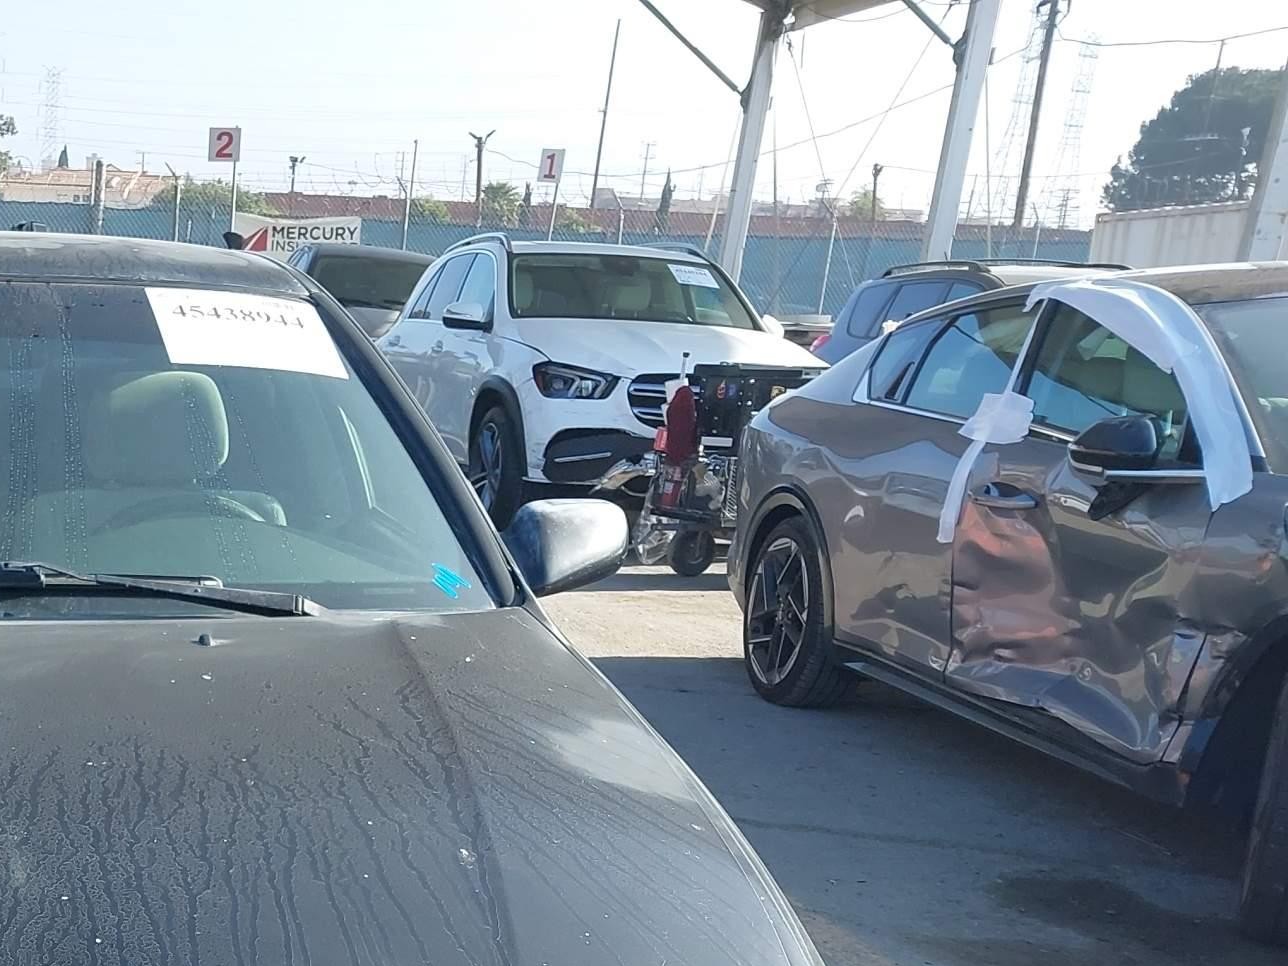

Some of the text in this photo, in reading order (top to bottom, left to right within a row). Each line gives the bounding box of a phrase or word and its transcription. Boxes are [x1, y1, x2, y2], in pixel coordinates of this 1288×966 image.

[215, 131, 234, 158] 2
[544, 153, 557, 179] 1
[272, 226, 358, 241] MERCURY
